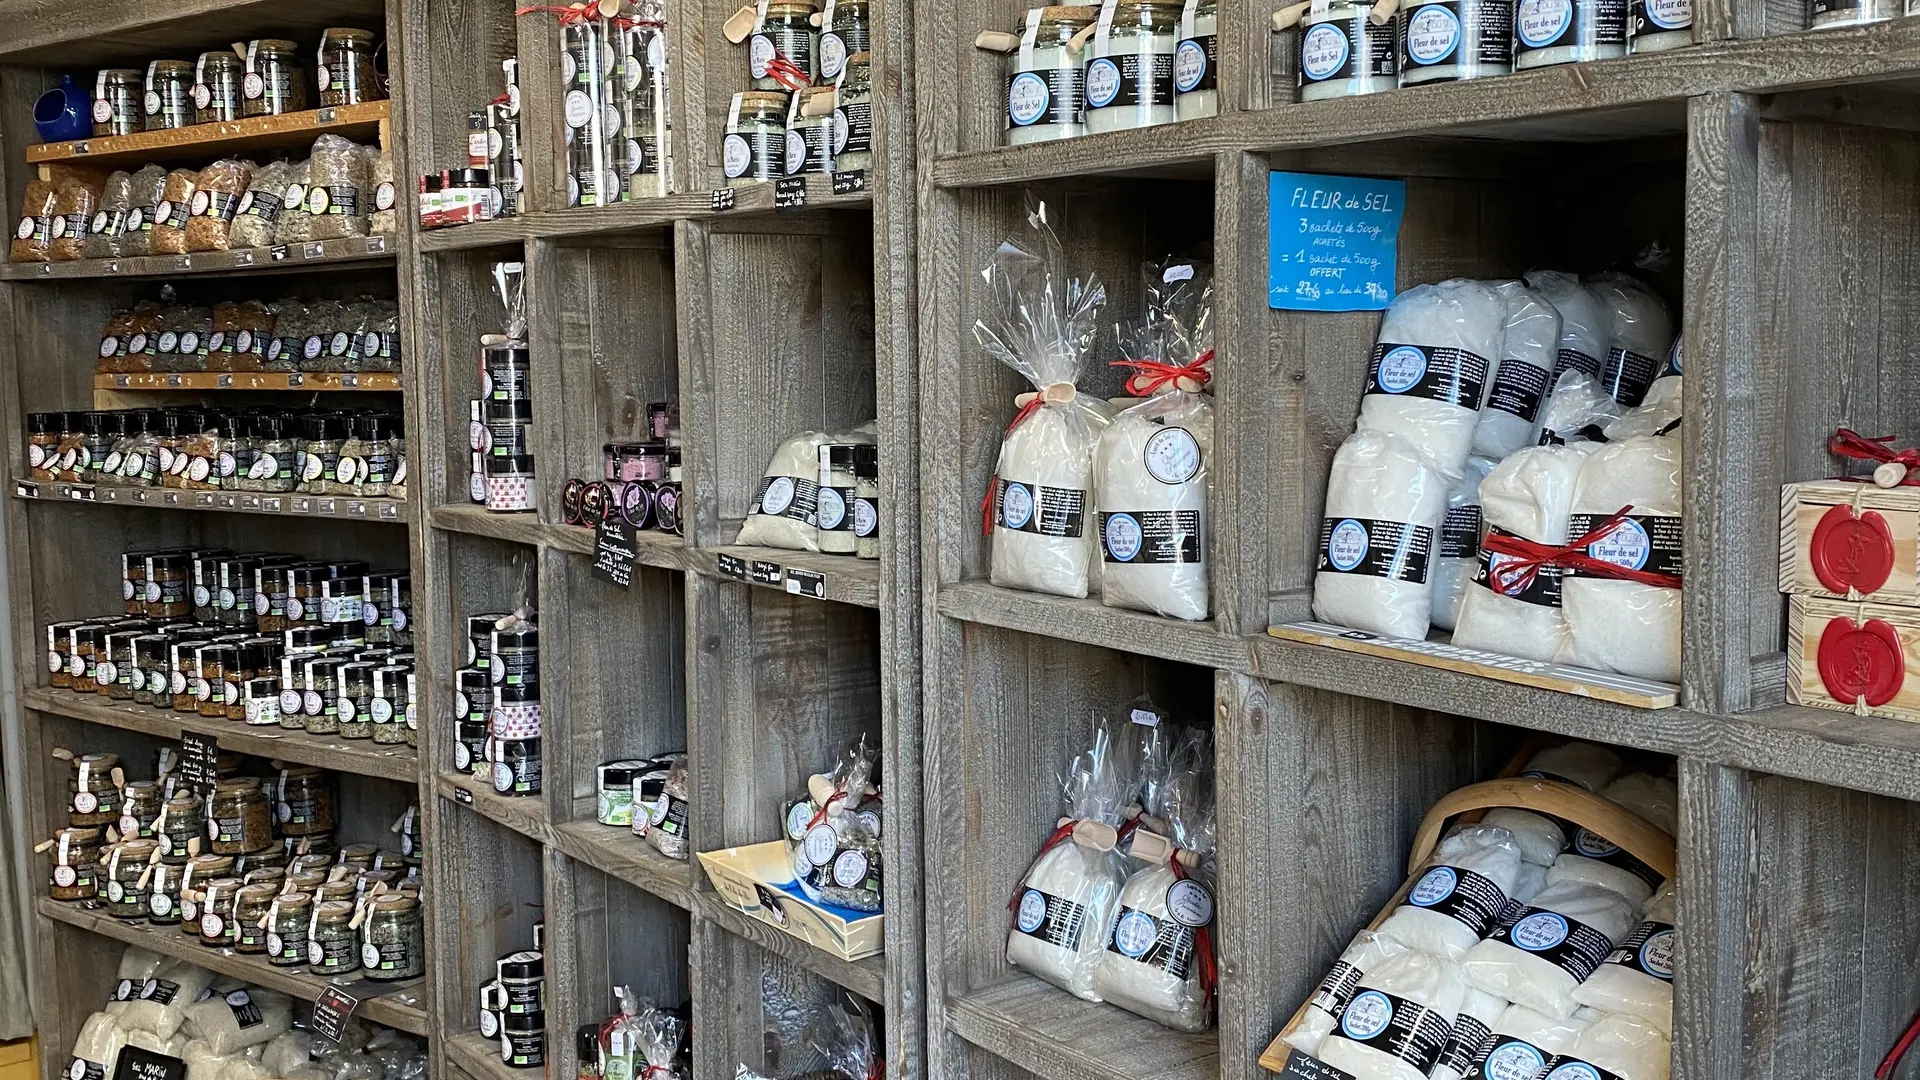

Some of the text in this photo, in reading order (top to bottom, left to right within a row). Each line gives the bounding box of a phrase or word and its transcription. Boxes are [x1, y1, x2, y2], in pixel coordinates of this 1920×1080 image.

[1655, 0, 1673, 10] Fleur
[1524, 16, 1561, 30] Fleur de sel
[1414, 35, 1450, 48] Fleur de sel
[1307, 51, 1338, 65] Fleur de Sel
[1013, 101, 1024, 111] Fleur
[1024, 101, 1031, 110] de
[1291, 187, 1392, 212] FLEUR de SEL
[1298, 218, 1382, 240] 3 sachets de 500g
[1295, 249, 1305, 263] 1
[1309, 252, 1338, 264] sachet
[1341, 253, 1352, 264] de
[1353, 253, 1381, 271] 500g
[1309, 267, 1346, 280] OFFERT
[1337, 284, 1353, 295] lieu
[1353, 286, 1362, 294] de
[1384, 369, 1416, 378] Fleur de sel
[1334, 544, 1346, 553] Fleur
[1346, 544, 1352, 553] de
[1598, 546, 1638, 558] Fleur de sel
[1520, 925, 1554, 943] Fleur de sel
[1648, 947, 1666, 959] Fleur
[1350, 1011, 1363, 1021] Fleur
[1363, 1015, 1371, 1023] de
[1493, 1061, 1511, 1074] Fleur
[1512, 1066, 1521, 1076] de
